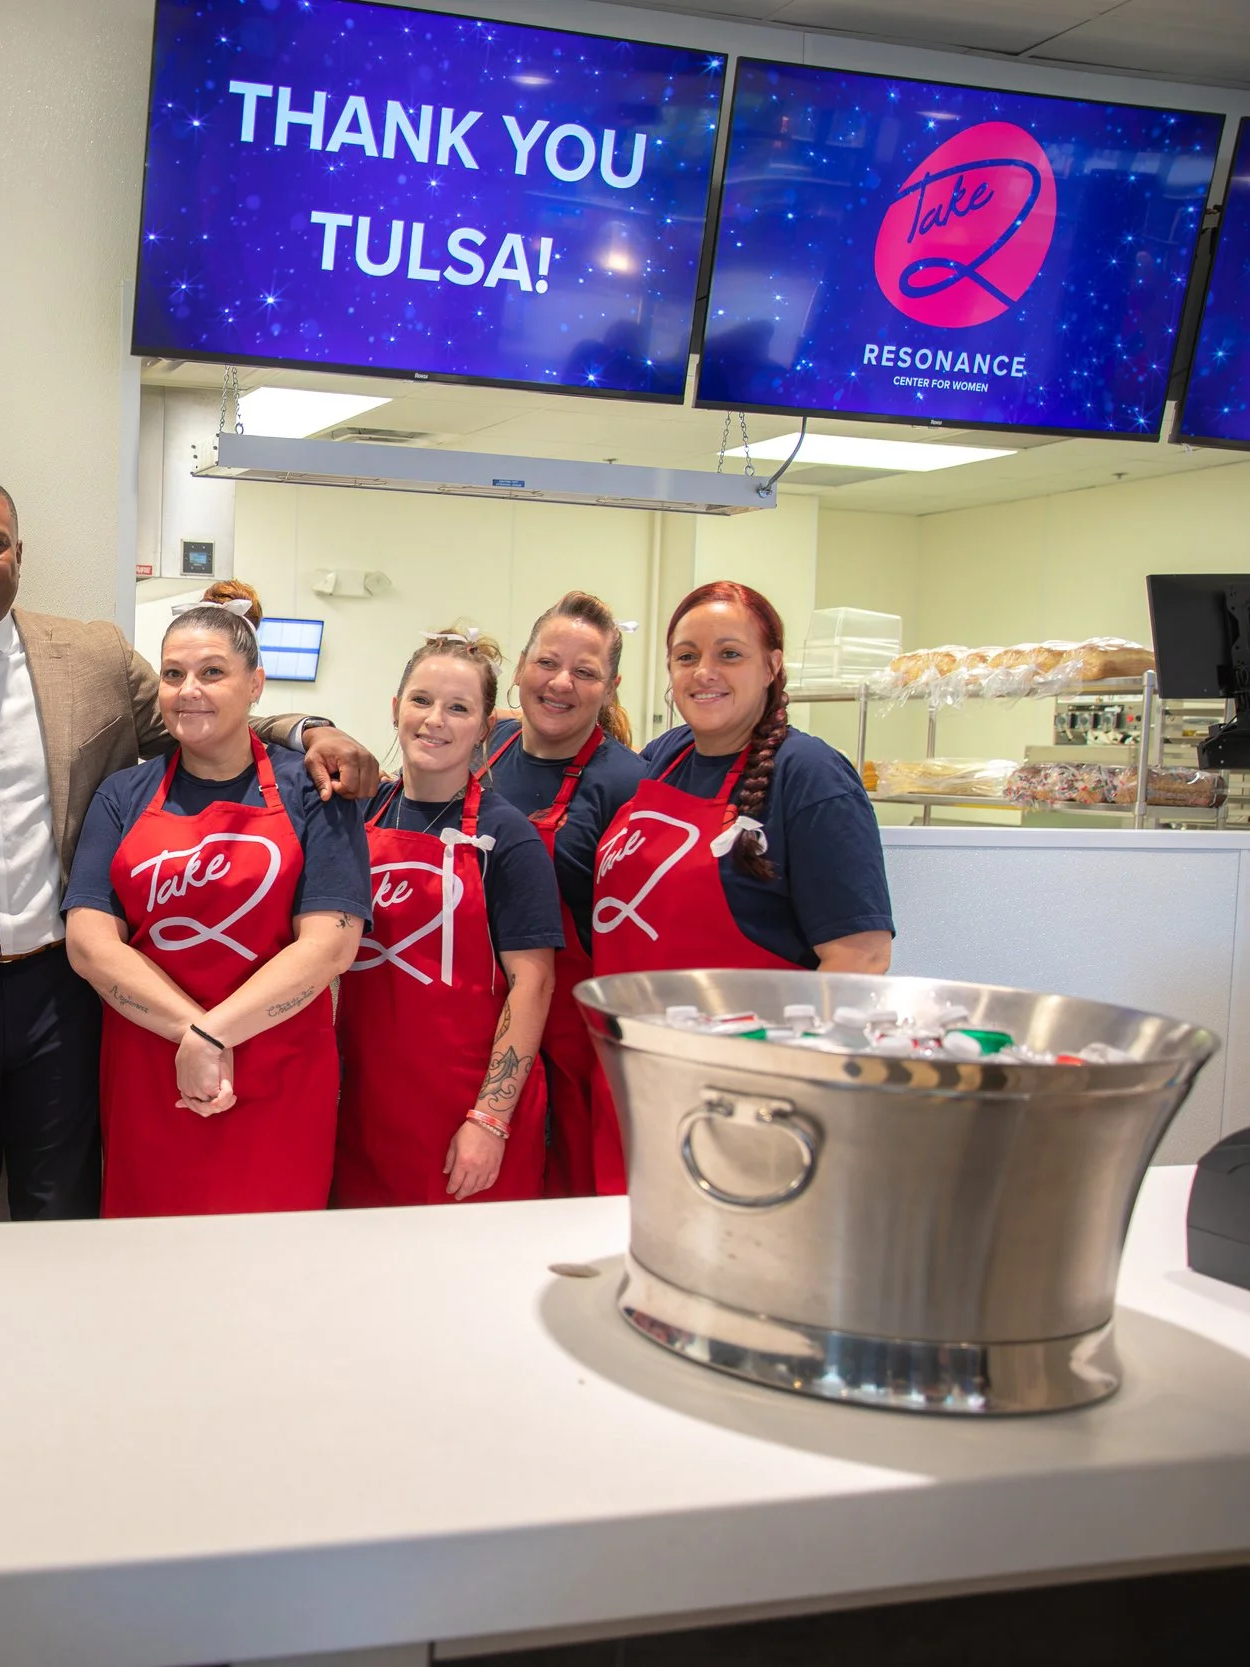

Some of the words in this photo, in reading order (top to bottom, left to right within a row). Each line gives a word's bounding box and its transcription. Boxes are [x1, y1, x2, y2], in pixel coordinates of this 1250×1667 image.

[228, 80, 484, 170] THANK
[502, 115, 648, 189] YOU
[896, 172, 995, 243] Take
[310, 210, 553, 295] TULSA!
[863, 343, 1027, 378] RESONANCE
[893, 375, 930, 388] CENTER
[931, 378, 951, 390] FOR
[952, 380, 989, 393] WOMEN
[131, 847, 232, 913] Take
[149, 832, 282, 962] 2
[371, 871, 414, 913] ke
